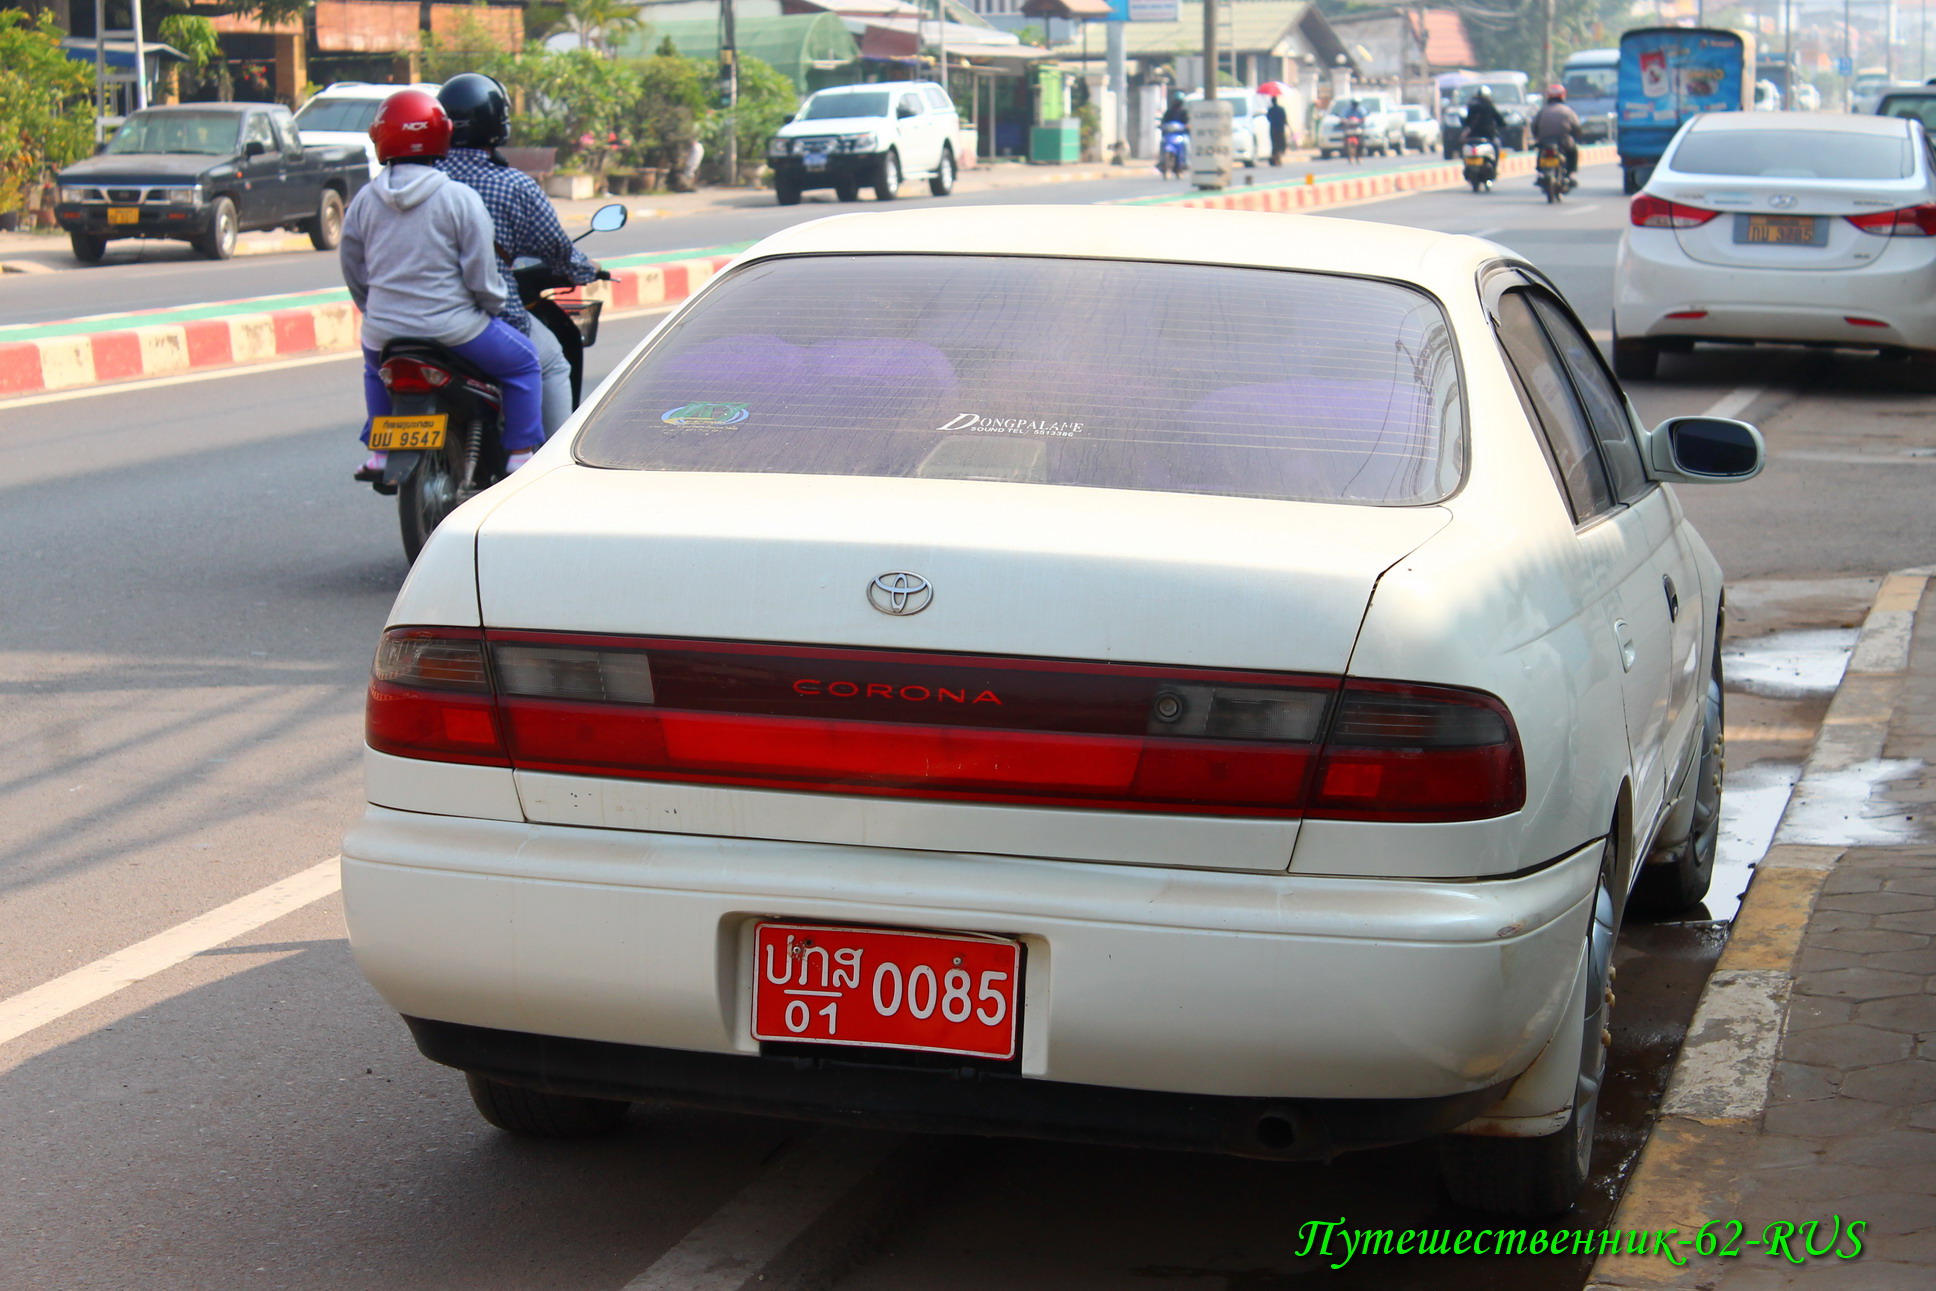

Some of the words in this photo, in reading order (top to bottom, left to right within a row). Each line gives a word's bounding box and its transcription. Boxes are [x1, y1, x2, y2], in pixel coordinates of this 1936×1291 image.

[400, 431, 440, 446] 9547
[793, 678, 1003, 705] CORONA
[766, 934, 864, 989] ປກສ
[872, 961, 1008, 1027] 0085
[784, 1000, 838, 1035] 01
